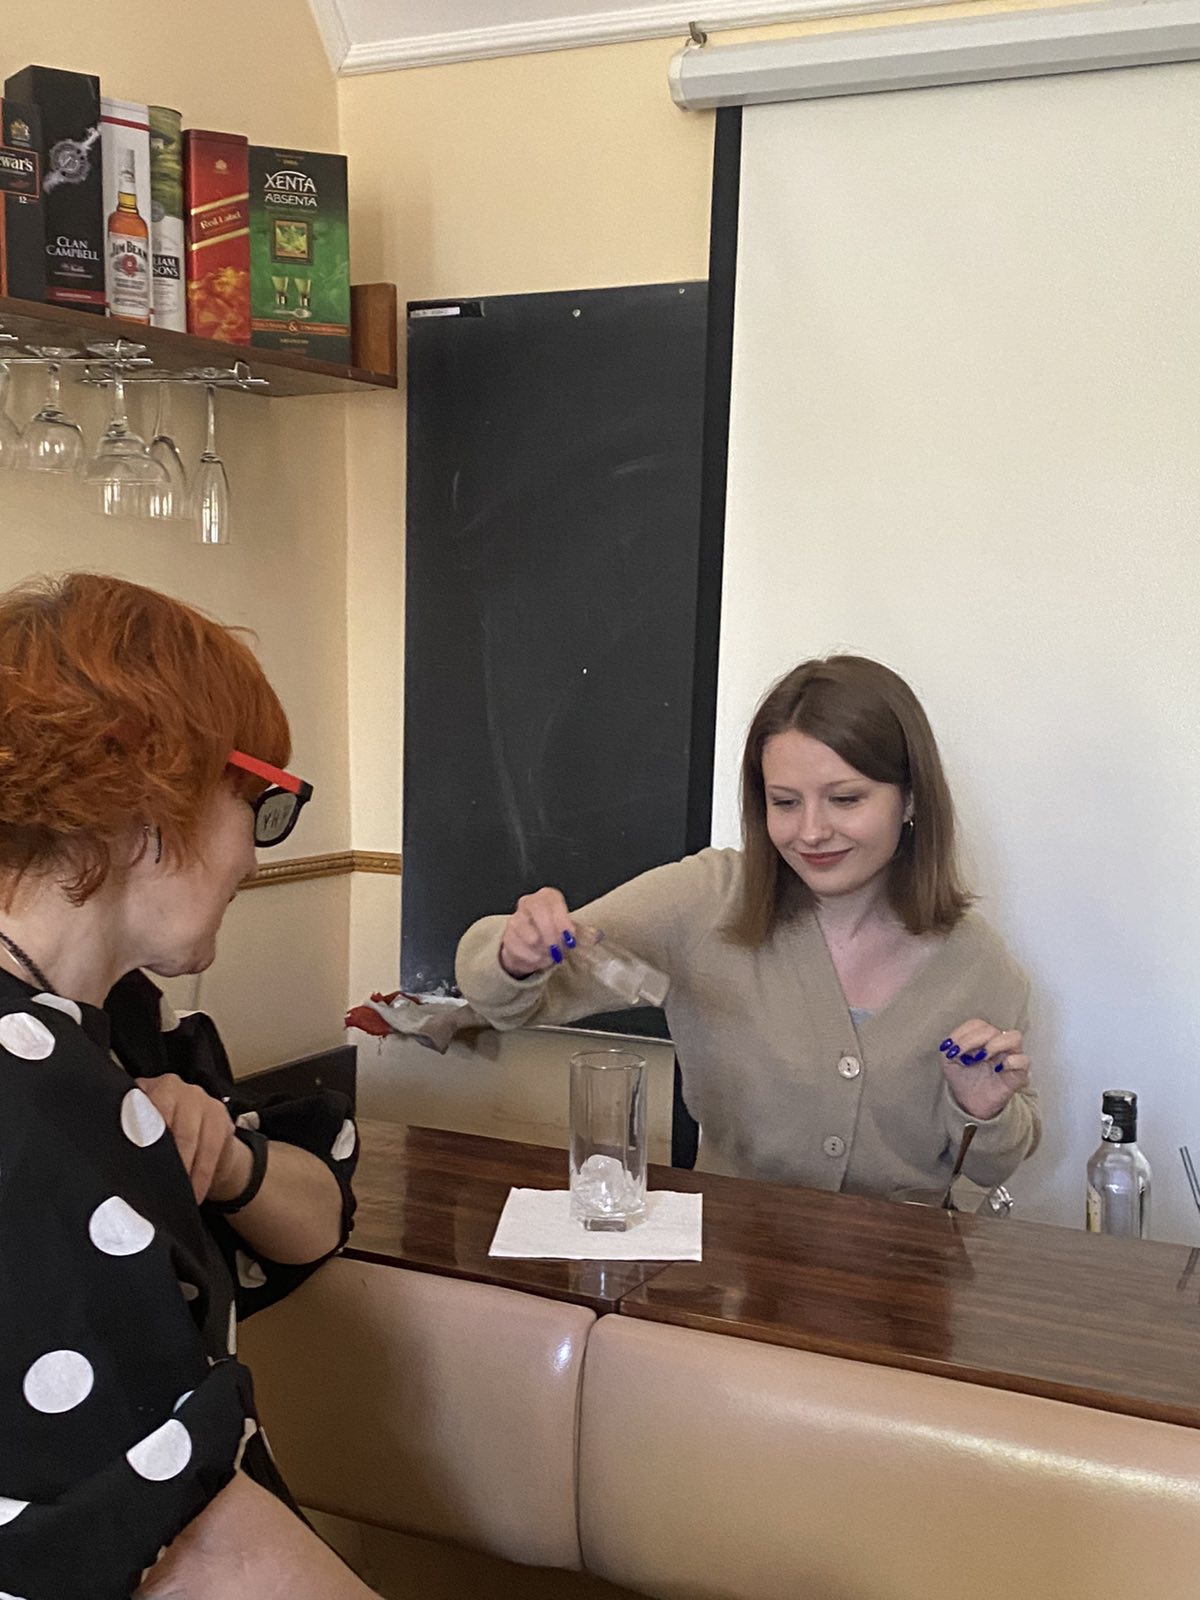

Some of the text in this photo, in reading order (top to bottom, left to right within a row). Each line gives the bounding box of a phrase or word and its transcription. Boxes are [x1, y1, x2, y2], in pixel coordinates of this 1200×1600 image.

[0, 156, 34, 172] war's
[264, 170, 317, 193] XENTA
[264, 193, 318, 207] ABSENTA
[56, 236, 88, 249] CLAN
[46, 245, 100, 261] CAMPBELL
